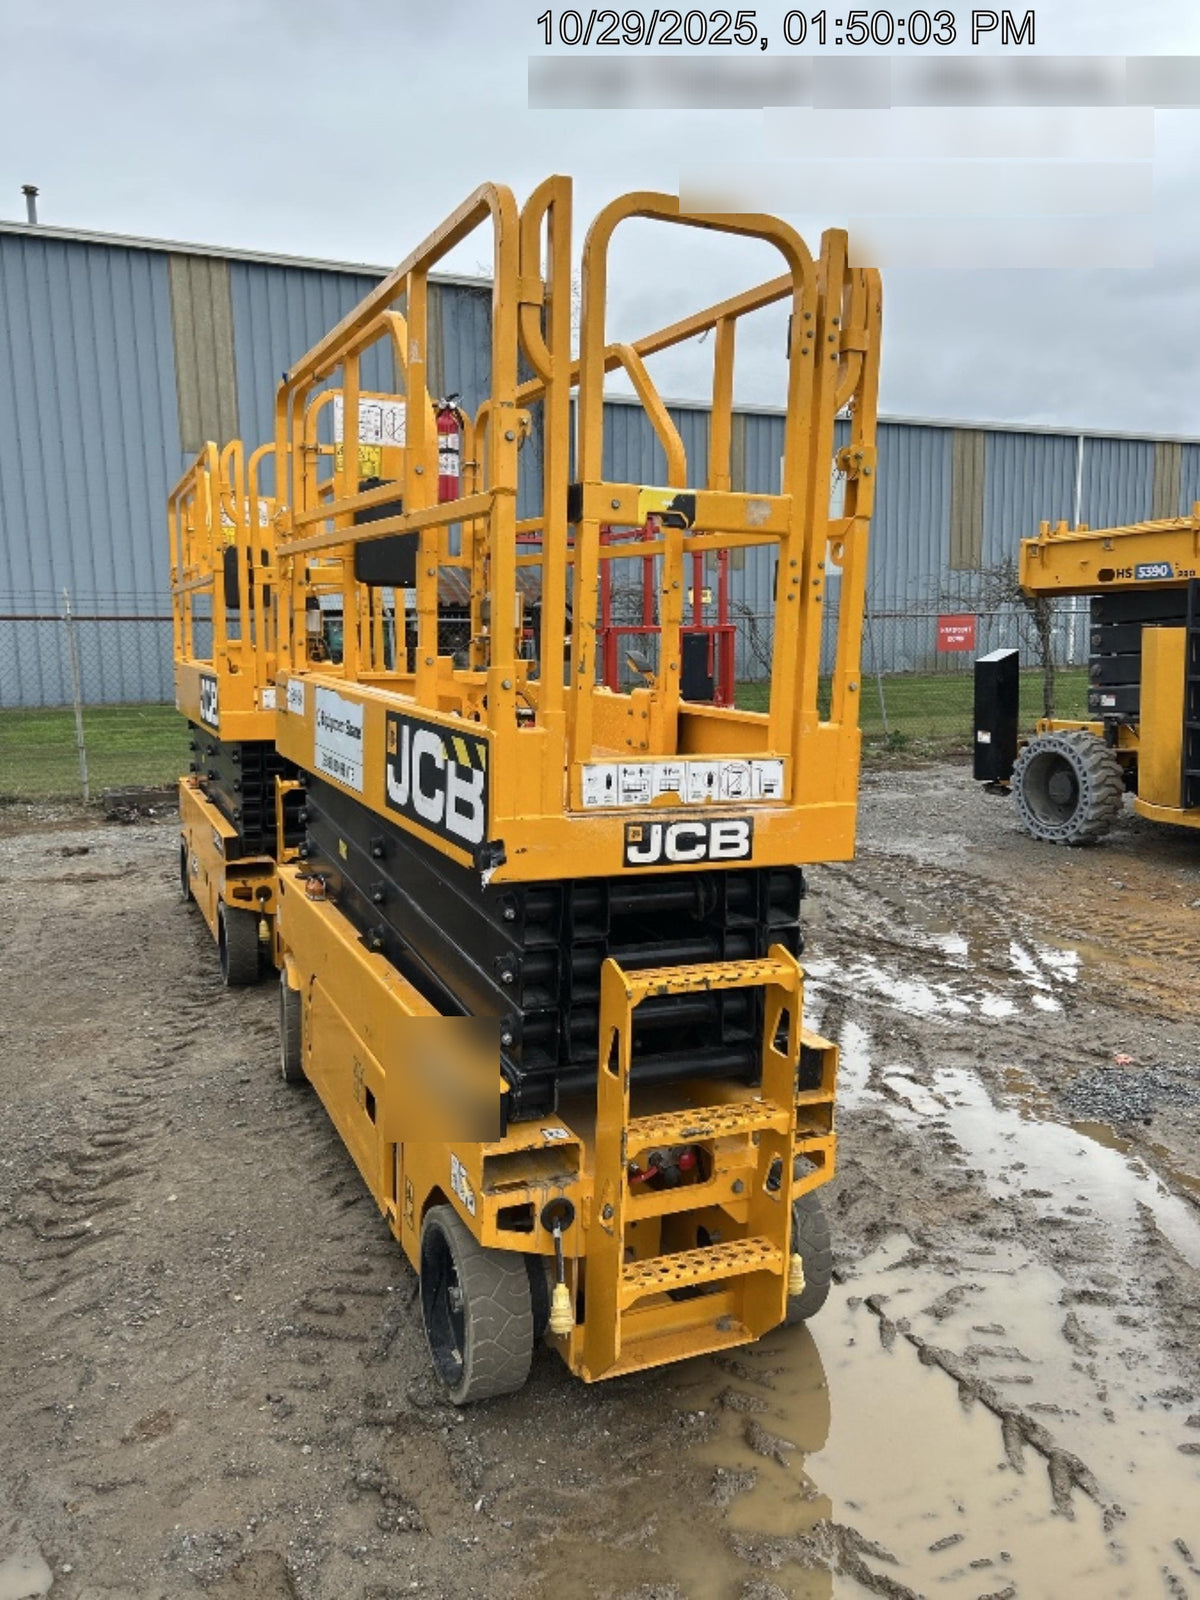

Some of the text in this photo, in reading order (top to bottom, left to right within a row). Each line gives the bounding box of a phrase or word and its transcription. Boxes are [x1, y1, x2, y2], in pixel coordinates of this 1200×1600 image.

[1116, 567, 1133, 579] HS
[1137, 564, 1168, 579] 5390
[386, 724, 485, 845] JCB
[626, 820, 750, 864] JCB
